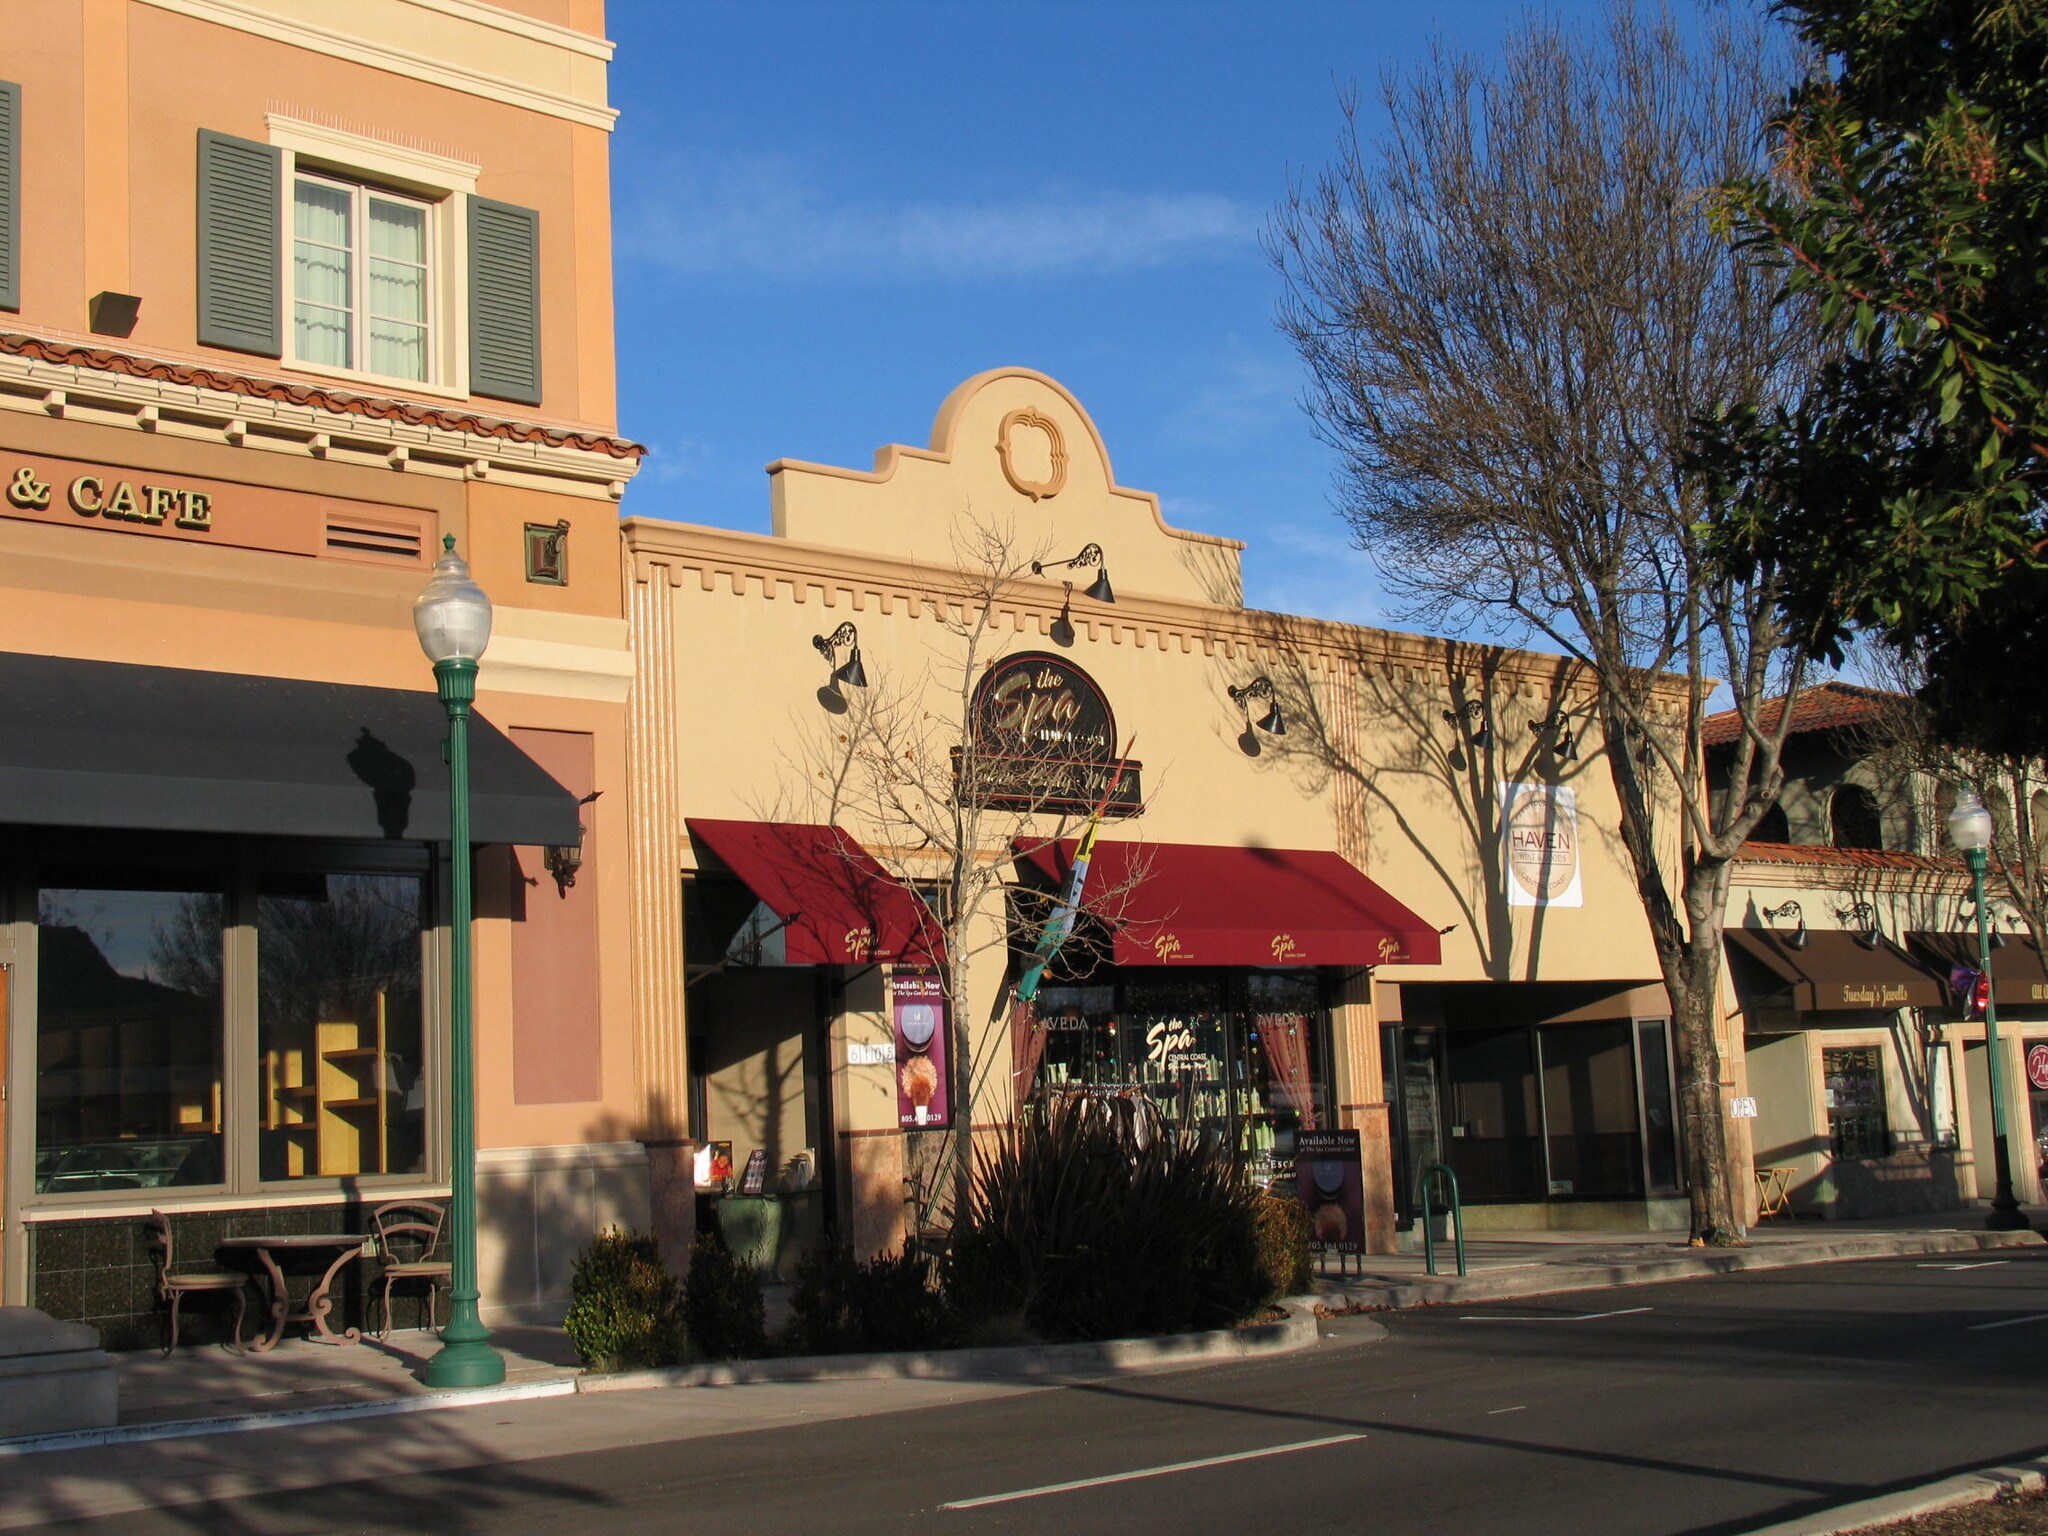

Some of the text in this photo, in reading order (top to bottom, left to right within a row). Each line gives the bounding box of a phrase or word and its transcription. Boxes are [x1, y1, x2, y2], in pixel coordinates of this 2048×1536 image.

[6, 467, 213, 532] & CAFE
[1036, 669, 1064, 689] the
[994, 672, 1082, 743] Spa
[1512, 830, 1570, 849] HAVEN
[845, 929, 879, 960] Spa
[1155, 936, 1181, 964] Spa
[1271, 936, 1297, 962] Spa
[1378, 938, 1400, 964] Spa
[925, 981, 941, 990] Now
[1843, 984, 1880, 1007] Tuesday's
[1168, 1018, 1183, 1031] the
[851, 1046, 894, 1061] 6105
[1146, 1022, 1194, 1072] Spa
[1168, 1053, 1207, 1062] CENTRAL COAST
[1732, 1098, 1756, 1116] OPEN
[1299, 1135, 1356, 1146] Available Now
